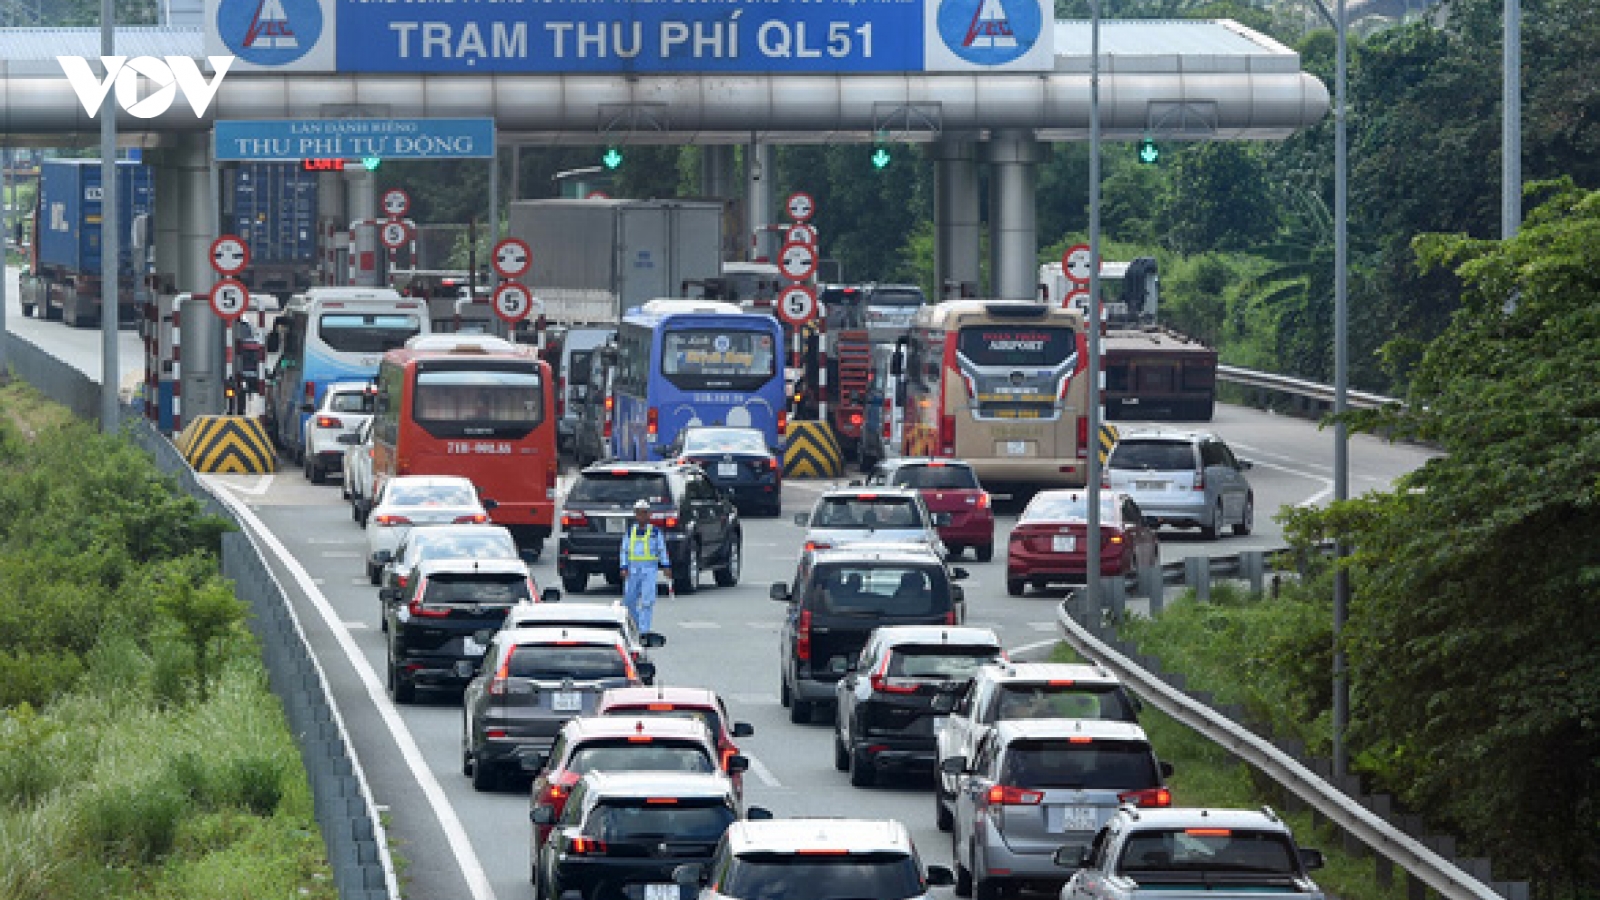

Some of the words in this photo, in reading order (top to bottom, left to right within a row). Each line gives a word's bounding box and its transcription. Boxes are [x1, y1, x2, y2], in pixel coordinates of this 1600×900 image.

[389, 21, 528, 66] TRẠM
[545, 21, 642, 59] THU
[660, 8, 743, 58] PHÍ
[757, 19, 873, 59] QL51
[235, 137, 291, 156] THU
[395, 133, 474, 157] ĐỘNG
[388, 225, 400, 242] 5
[222, 289, 237, 309] 5
[504, 291, 520, 312] 5
[791, 294, 804, 313] 5
